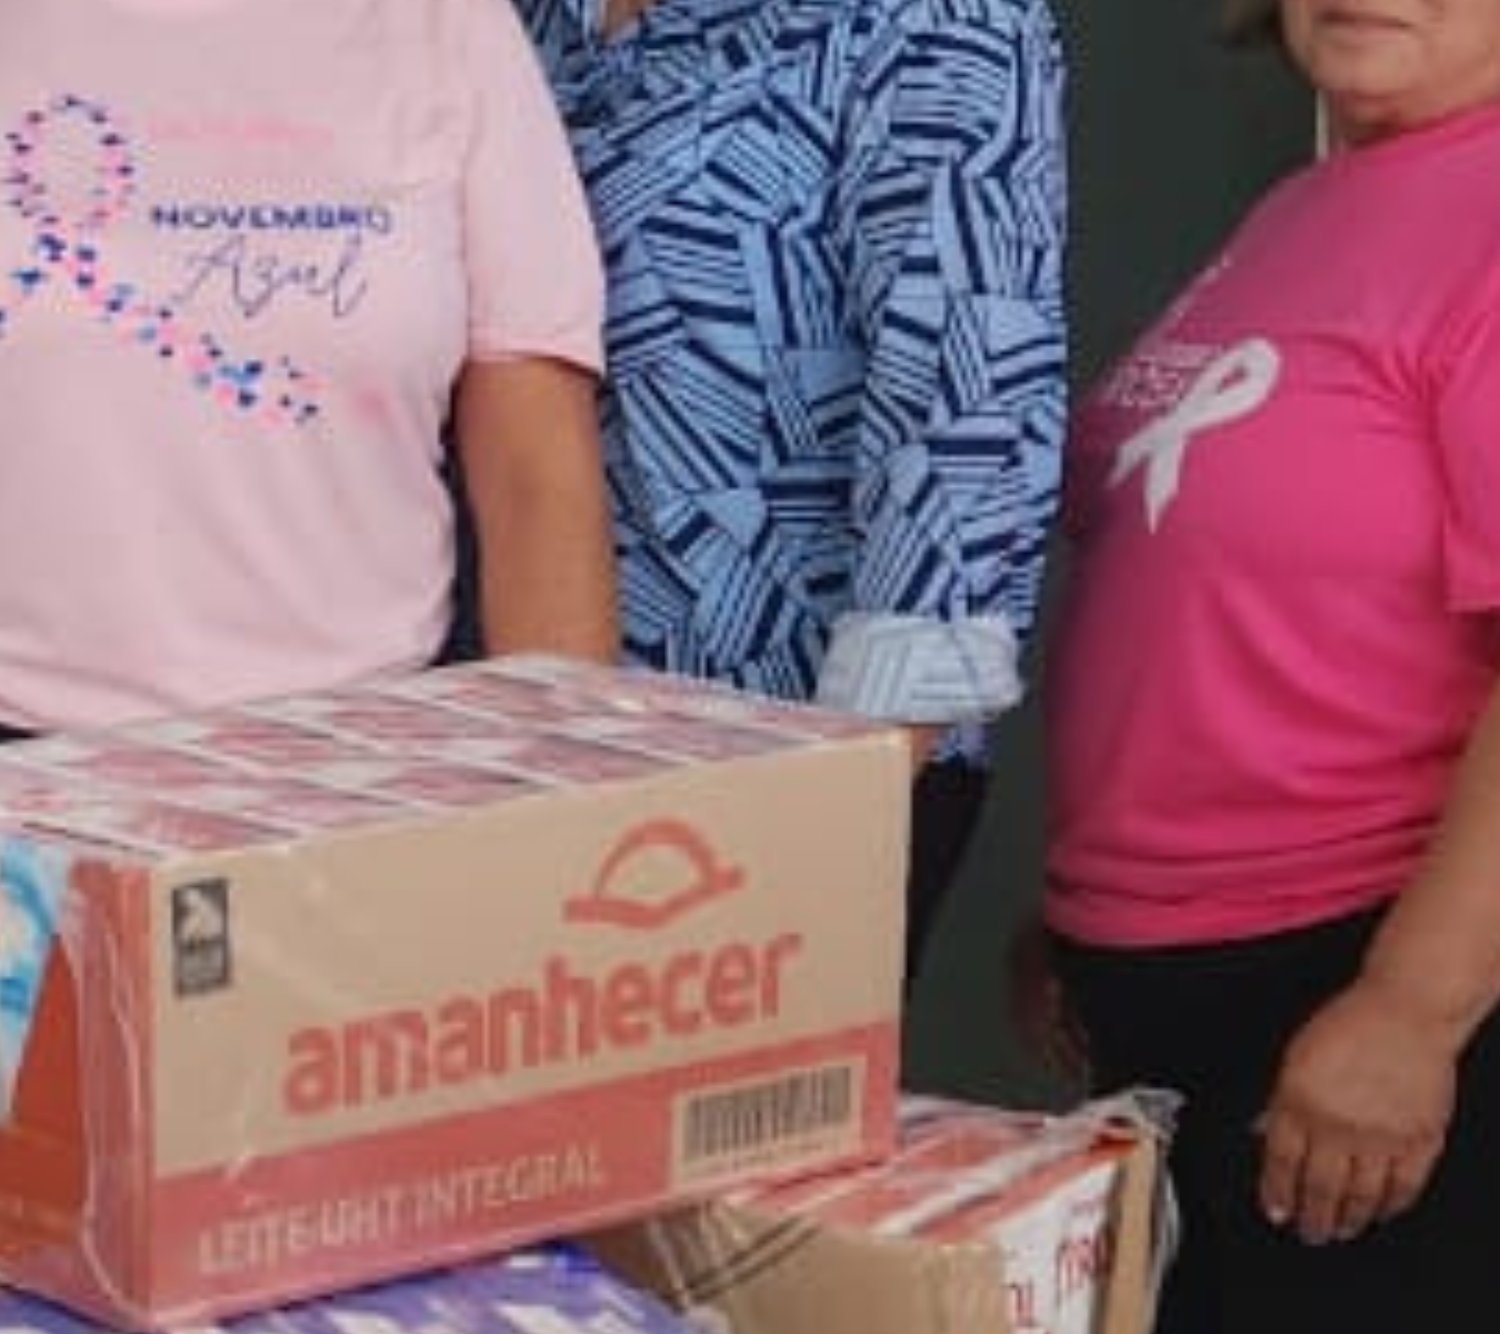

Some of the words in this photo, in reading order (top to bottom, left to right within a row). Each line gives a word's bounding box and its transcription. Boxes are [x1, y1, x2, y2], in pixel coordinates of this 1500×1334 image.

[150, 204, 392, 233] NOVEMBRO
[283, 932, 800, 1119] amanhecer
[412, 1143, 605, 1227] INTEGRAL
